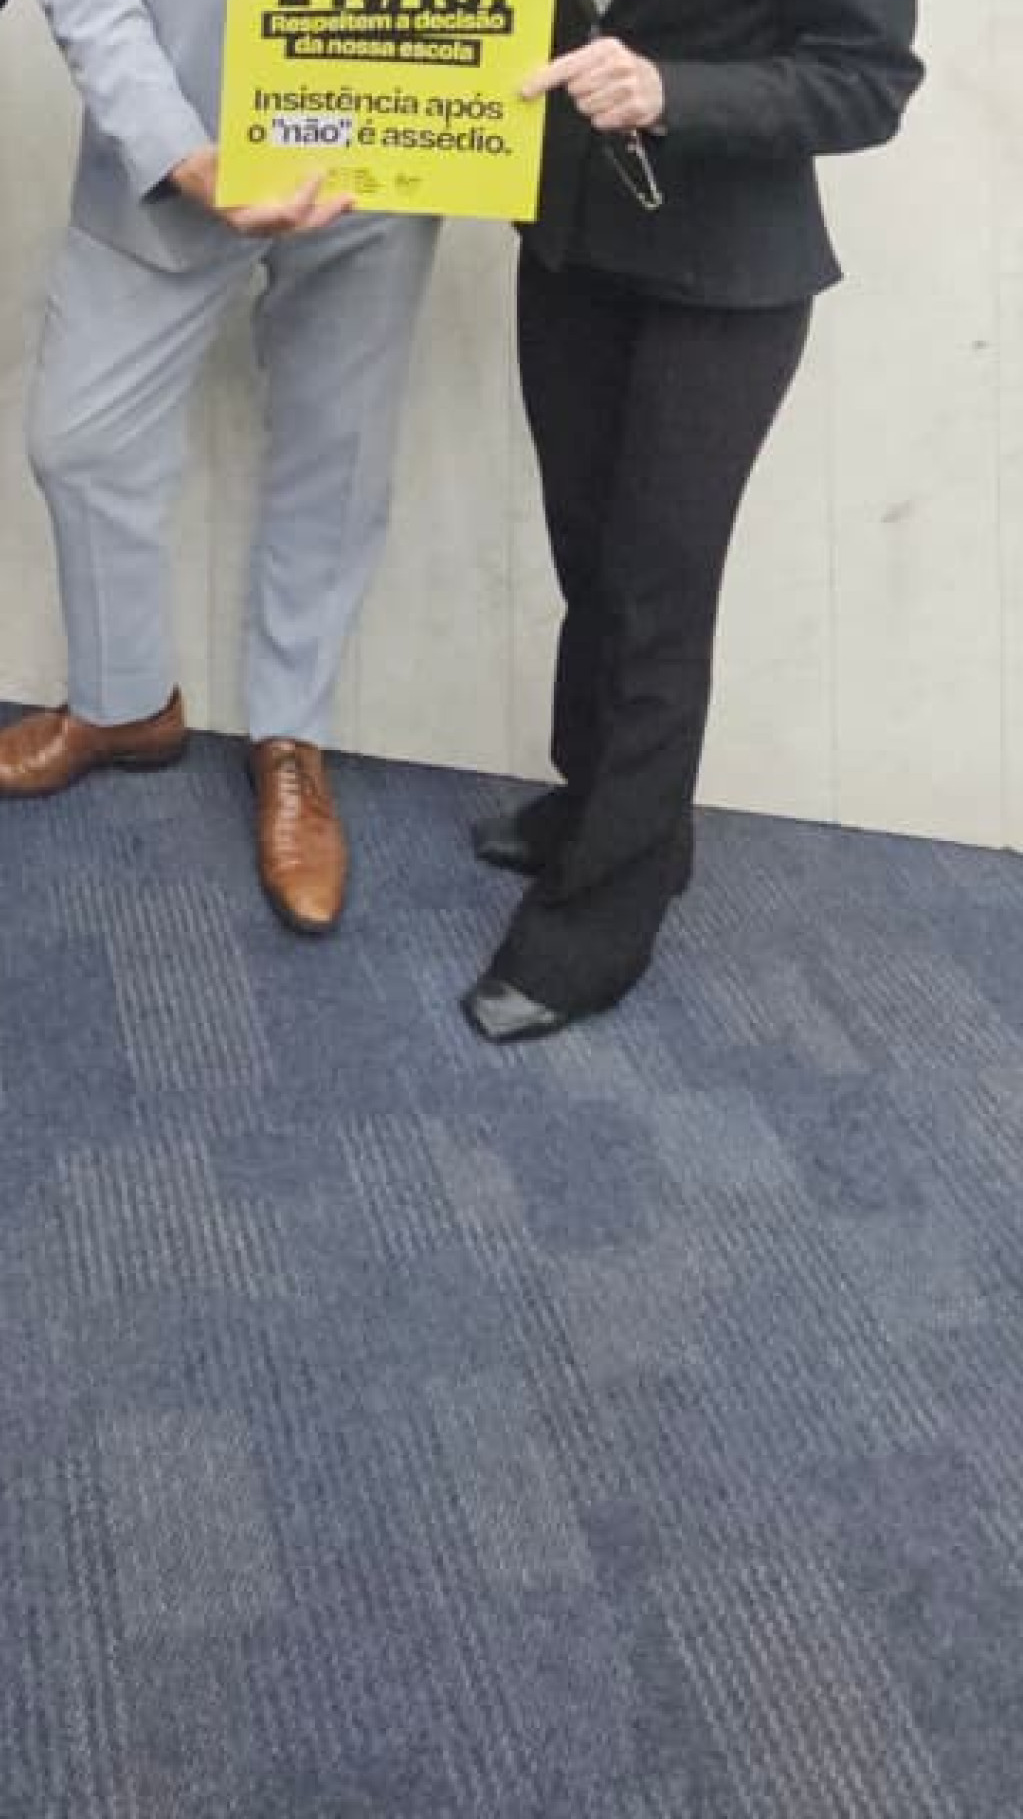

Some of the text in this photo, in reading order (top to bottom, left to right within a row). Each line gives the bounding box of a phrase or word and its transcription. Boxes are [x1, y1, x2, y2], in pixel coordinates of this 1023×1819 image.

[271, 8, 505, 34] Respeitem a decisão
[294, 35, 475, 62] da nossa escola
[254, 85, 504, 128] Insistência após
[248, 117, 513, 155] o "não", é assédio.
